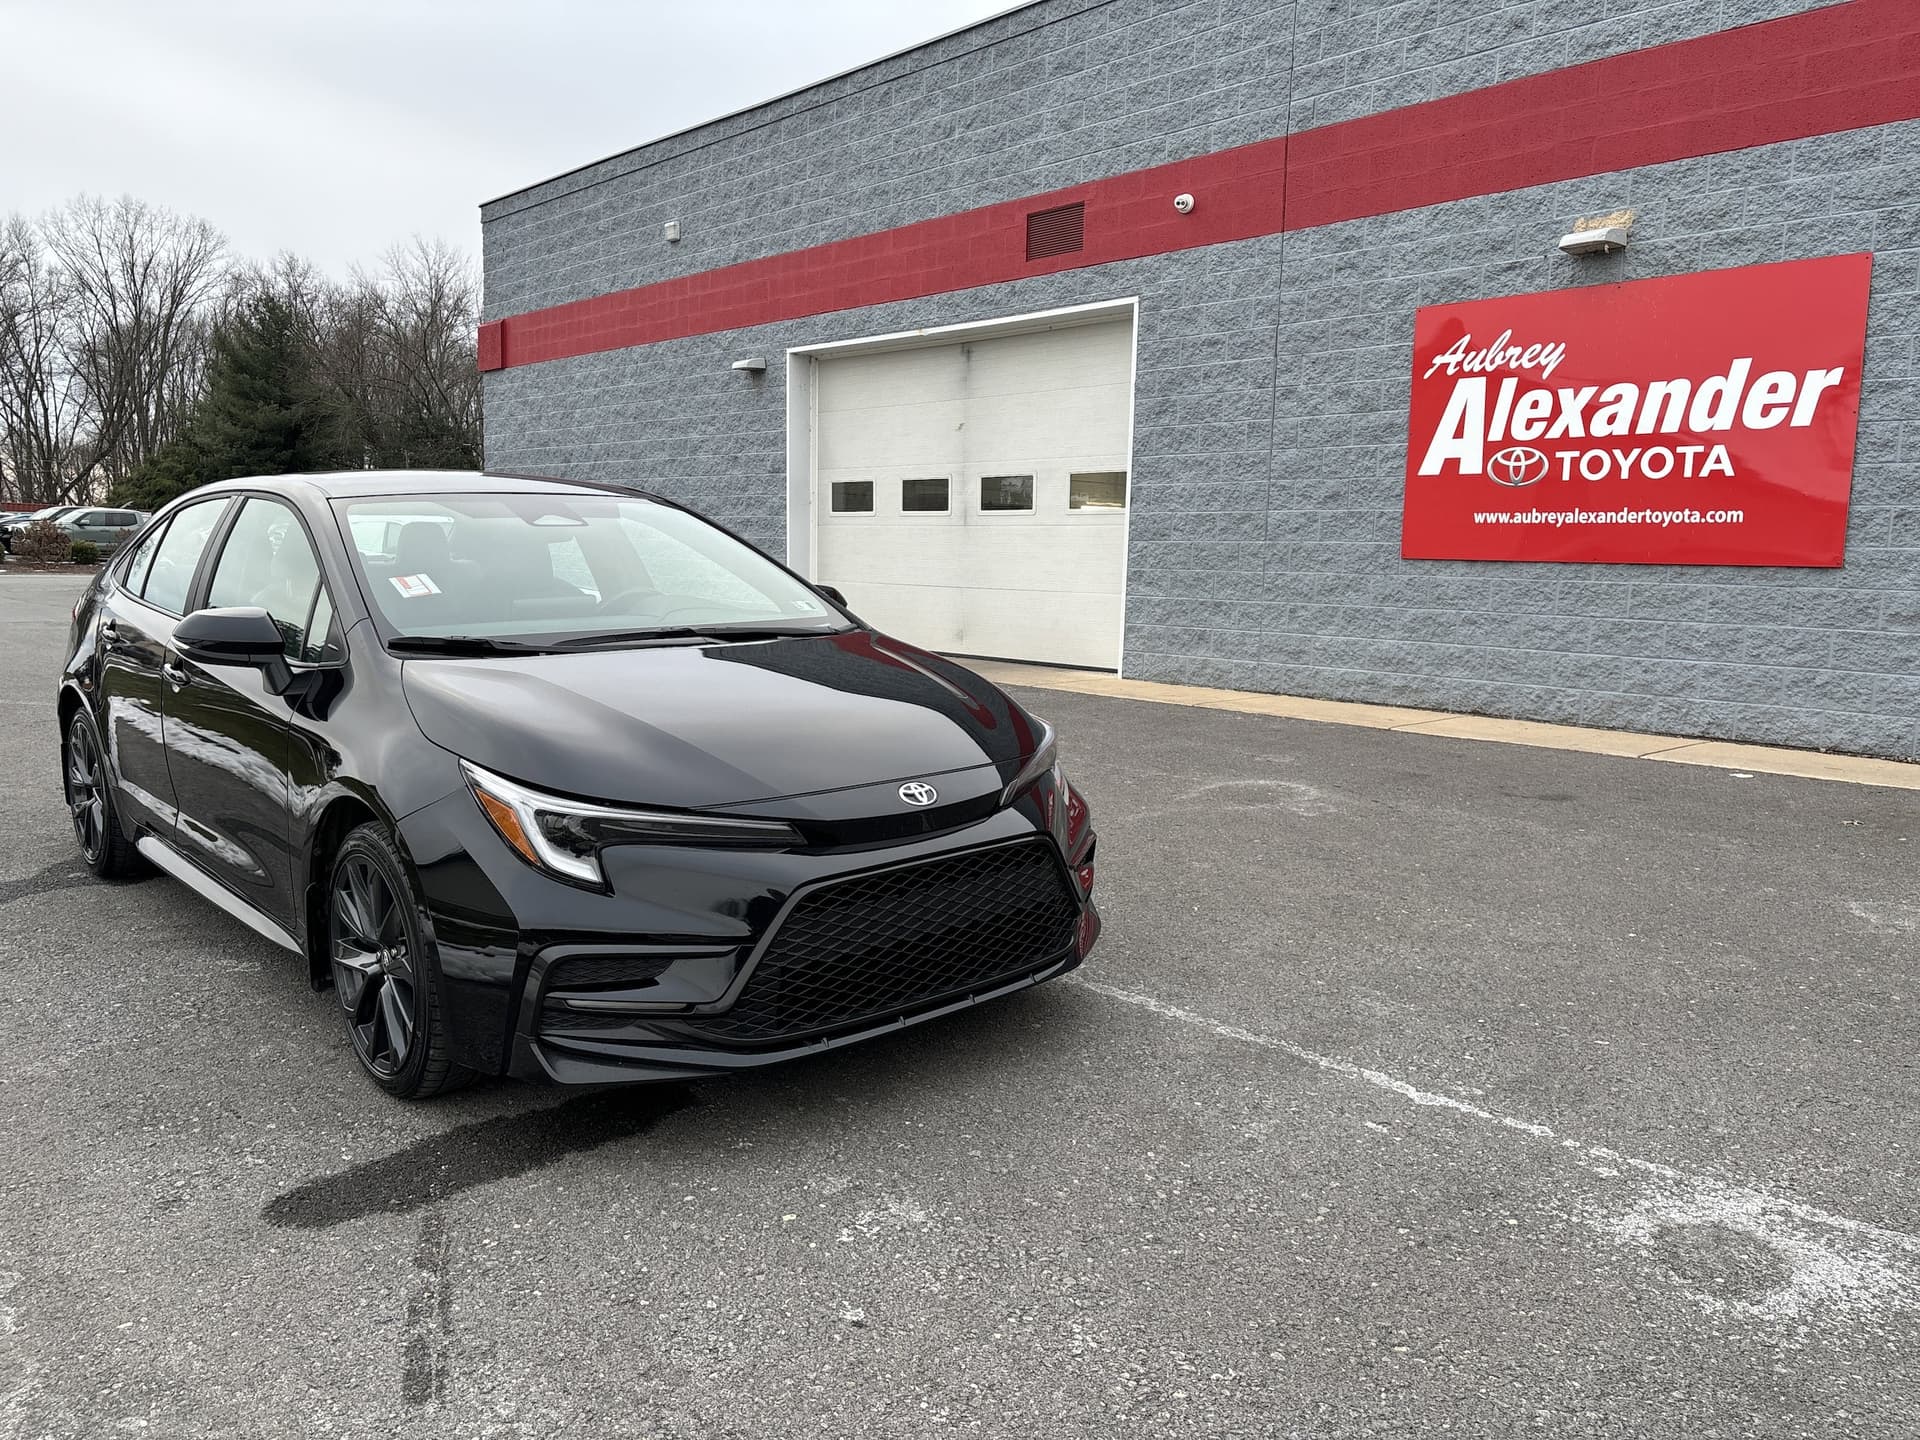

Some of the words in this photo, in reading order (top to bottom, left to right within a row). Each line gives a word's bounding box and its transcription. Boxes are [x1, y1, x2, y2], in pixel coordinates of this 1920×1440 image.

[1423, 329, 1566, 379] Aubrey
[1417, 358, 1844, 476] Alexander
[1556, 445, 1735, 481] TOYOTA
[1474, 507, 1744, 528] www.aubreyalexandertoyota.com
